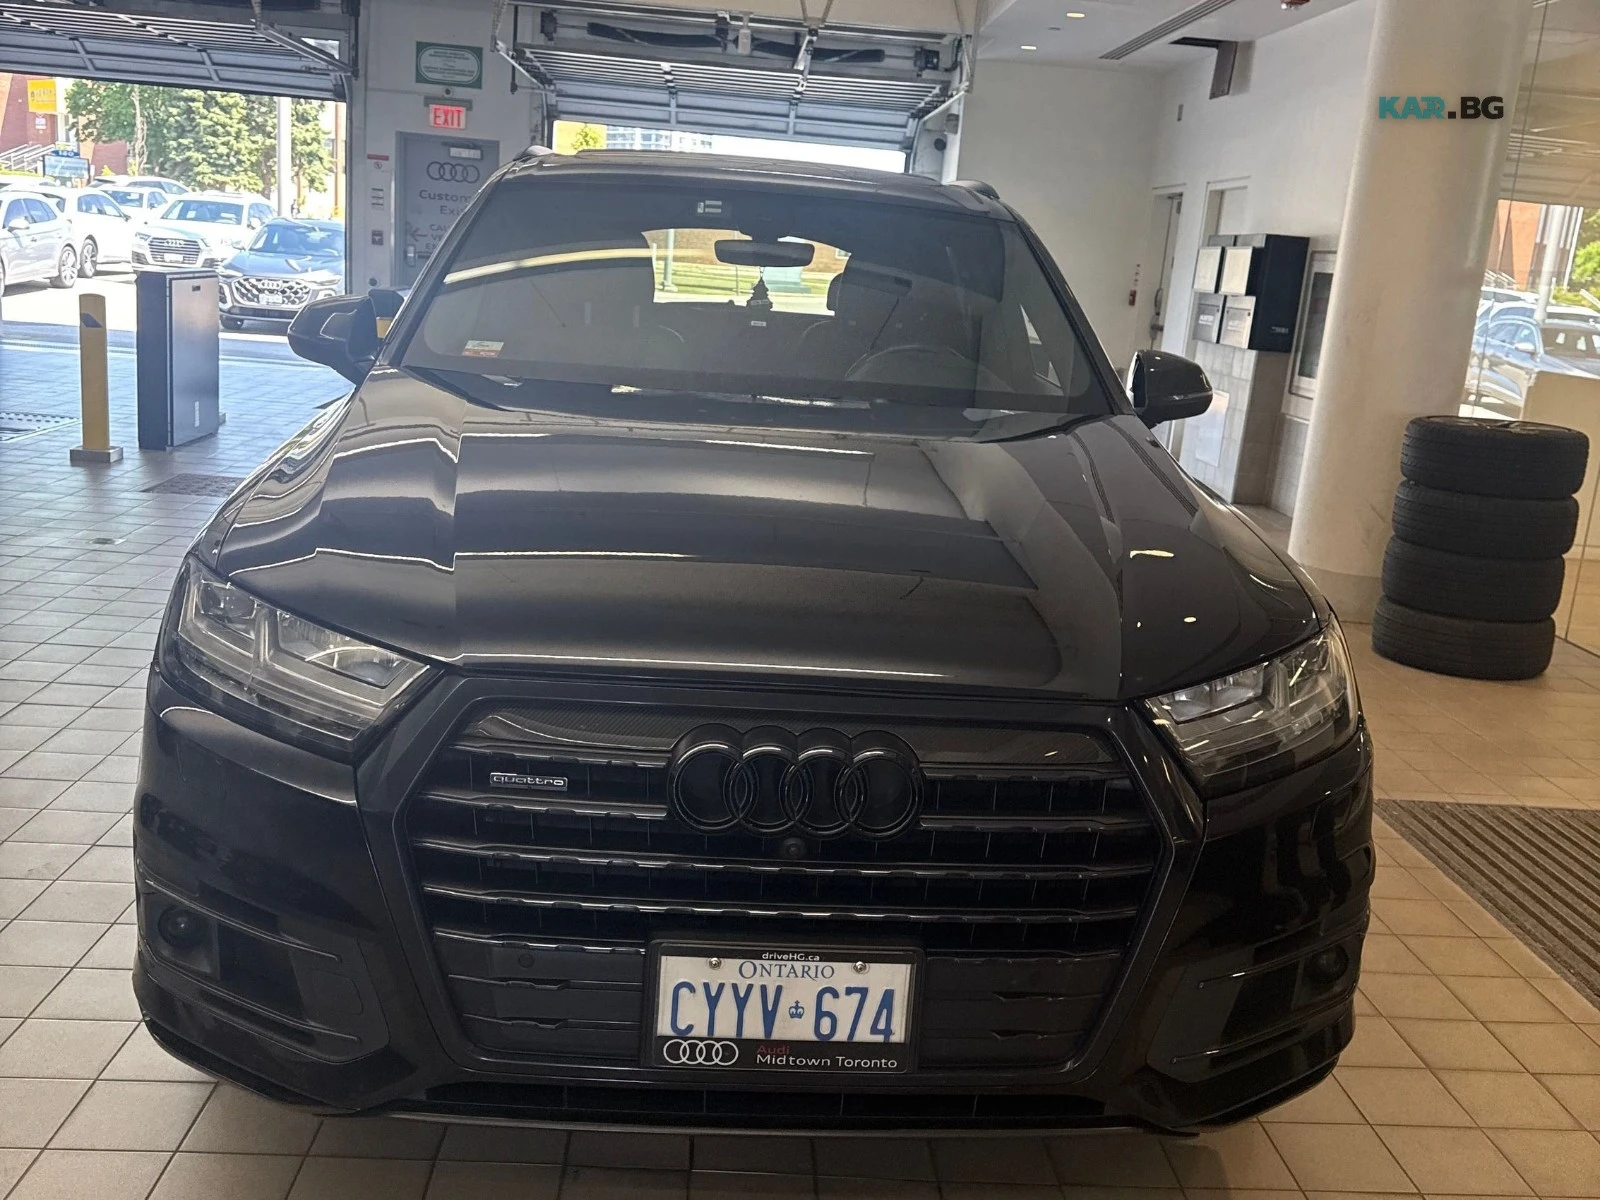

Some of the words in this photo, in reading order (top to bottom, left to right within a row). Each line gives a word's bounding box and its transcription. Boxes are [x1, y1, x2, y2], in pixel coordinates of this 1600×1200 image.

[433, 107, 462, 127] EXIT
[493, 776, 564, 786] quattro
[762, 952, 820, 962] driveHG.ca
[738, 960, 835, 981] ONTARIO
[670, 981, 783, 1039] CYYV
[813, 986, 895, 1043] 674
[756, 1045, 790, 1055] Audi
[756, 1054, 831, 1067] Midtown
[836, 1056, 898, 1068] Toronto
